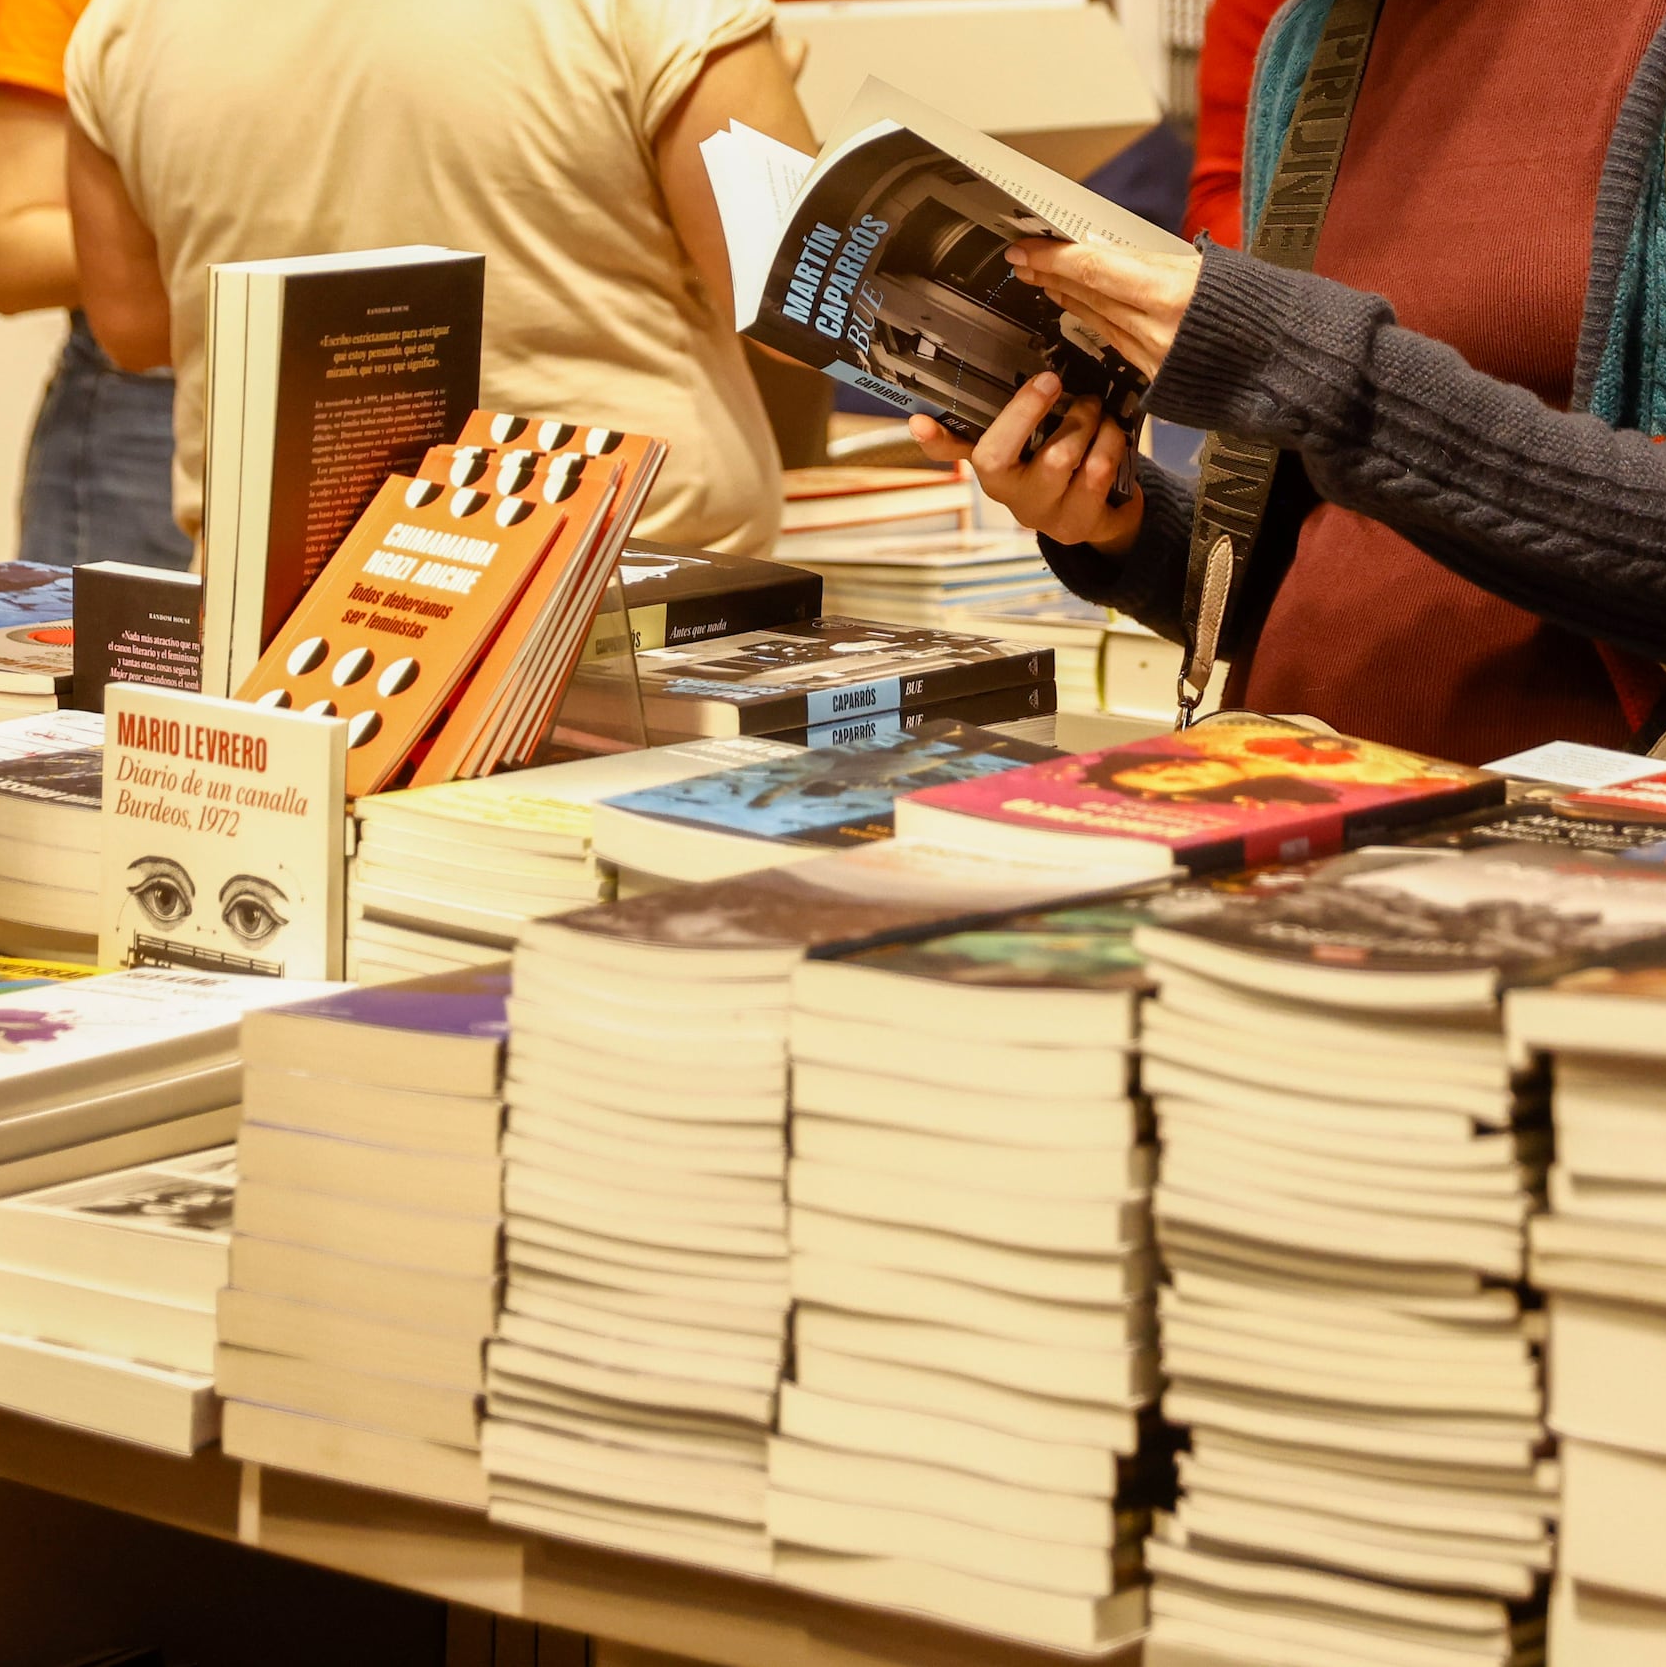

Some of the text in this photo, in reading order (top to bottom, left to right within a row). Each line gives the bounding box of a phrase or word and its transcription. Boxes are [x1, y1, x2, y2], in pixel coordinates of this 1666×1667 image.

[783, 222, 842, 324] MARTÍN
[815, 214, 889, 339] CAPARRÓS
[352, 331, 401, 343] estrictamente
[402, 329, 417, 341] para
[419, 325, 450, 337] averiguar
[847, 280, 884, 356] BUE
[348, 350, 366, 361] estoy
[418, 342, 435, 354] estoy
[374, 364, 386, 373] veo
[854, 376, 970, 432] CAPARRÓS BUE
[383, 523, 499, 566] CHIMAMANDA
[362, 550, 482, 594] NGOZI ADICHIE
[348, 582, 453, 620] Todos deberíamos
[149, 613, 190, 624] RANDOM HOUSE
[341, 609, 428, 640] ser feministas
[669, 618, 727, 640] Antes que nada
[108, 641, 199, 664] el canon literario y el feminismo
[121, 630, 141, 642] «Nada
[141, 633, 153, 644] más
[154, 636, 179, 648] atractivo
[180, 640, 191, 651] que
[109, 667, 128, 680] Mujer
[144, 673, 177, 687] sacándonos
[178, 679, 184, 688] el
[118, 658, 197, 677] y tantas otras cosas según lo
[832, 678, 924, 712] CAPARRÓS BUE
[117, 711, 267, 773] MARIO LEVRERO
[832, 712, 924, 745] CAPARRÓS BUE
[115, 755, 308, 817] Diario de un canalla
[115, 788, 240, 837] Burdeos, 1972
